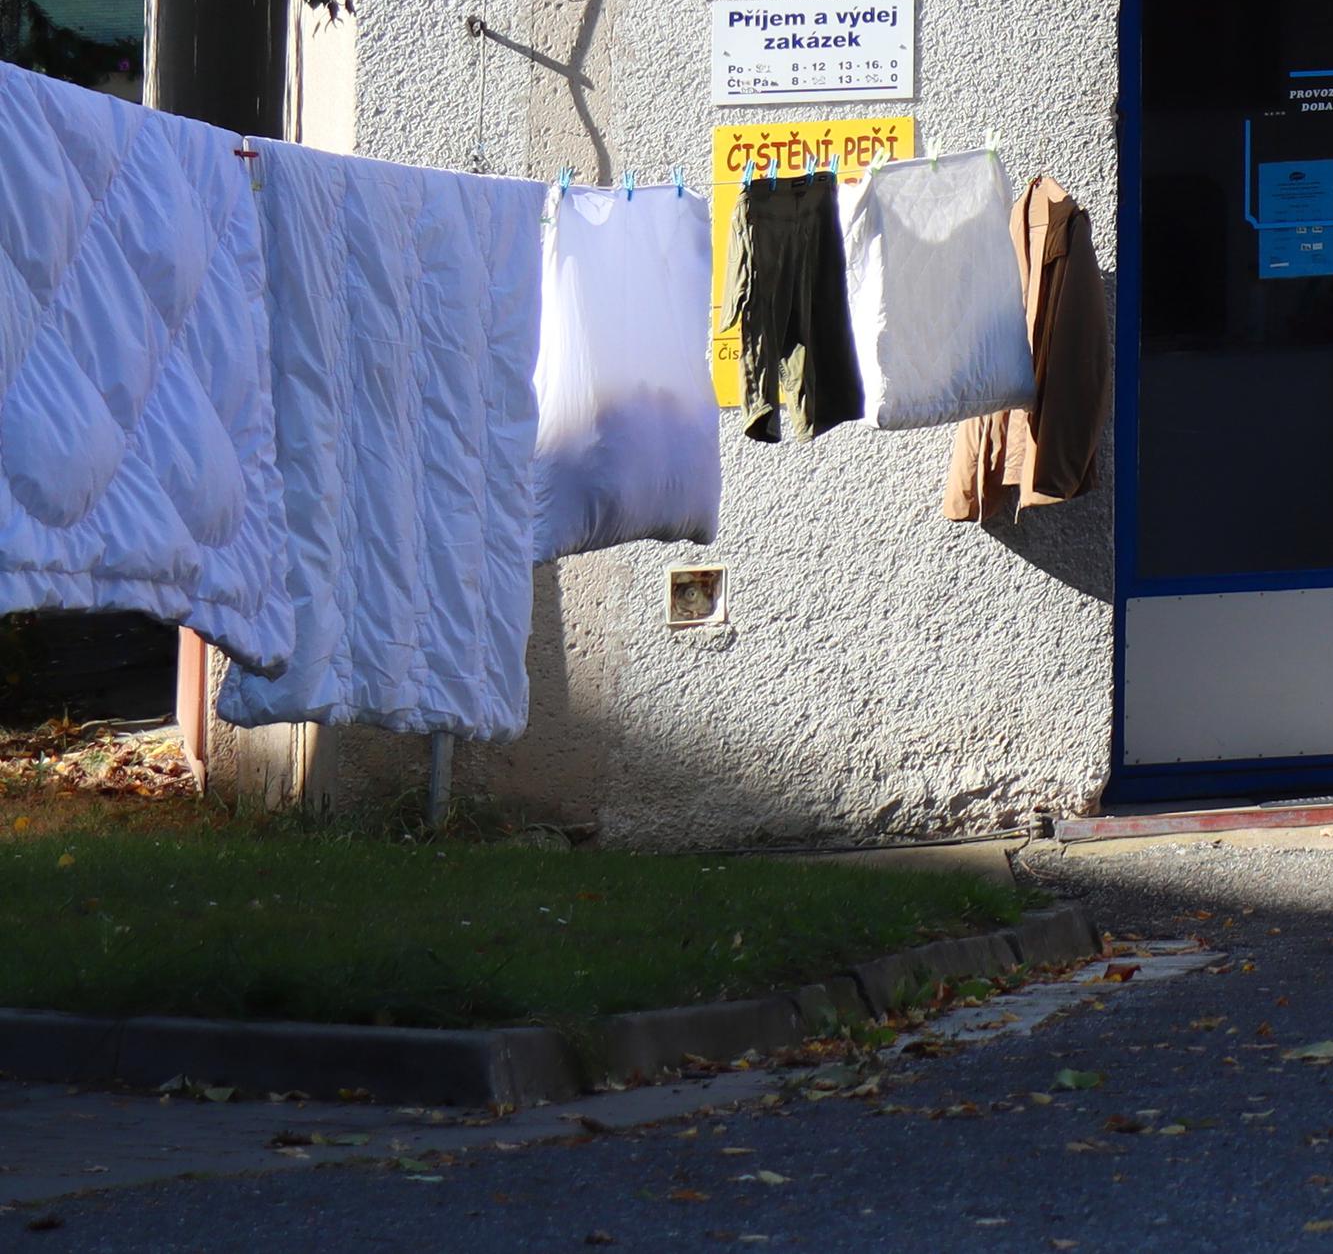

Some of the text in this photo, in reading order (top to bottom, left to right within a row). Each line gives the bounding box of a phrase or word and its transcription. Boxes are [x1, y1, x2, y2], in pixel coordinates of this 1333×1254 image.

[728, 6, 898, 30] Příjem a výdej
[763, 31, 861, 50] zakázek
[728, 65, 744, 74] Po
[792, 63, 799, 72] 8
[812, 62, 826, 71] 12
[838, 61, 852, 70] 13
[792, 77, 799, 86] 8
[838, 75, 852, 84] 13
[727, 129, 833, 172] ČIŠTĚNÍ
